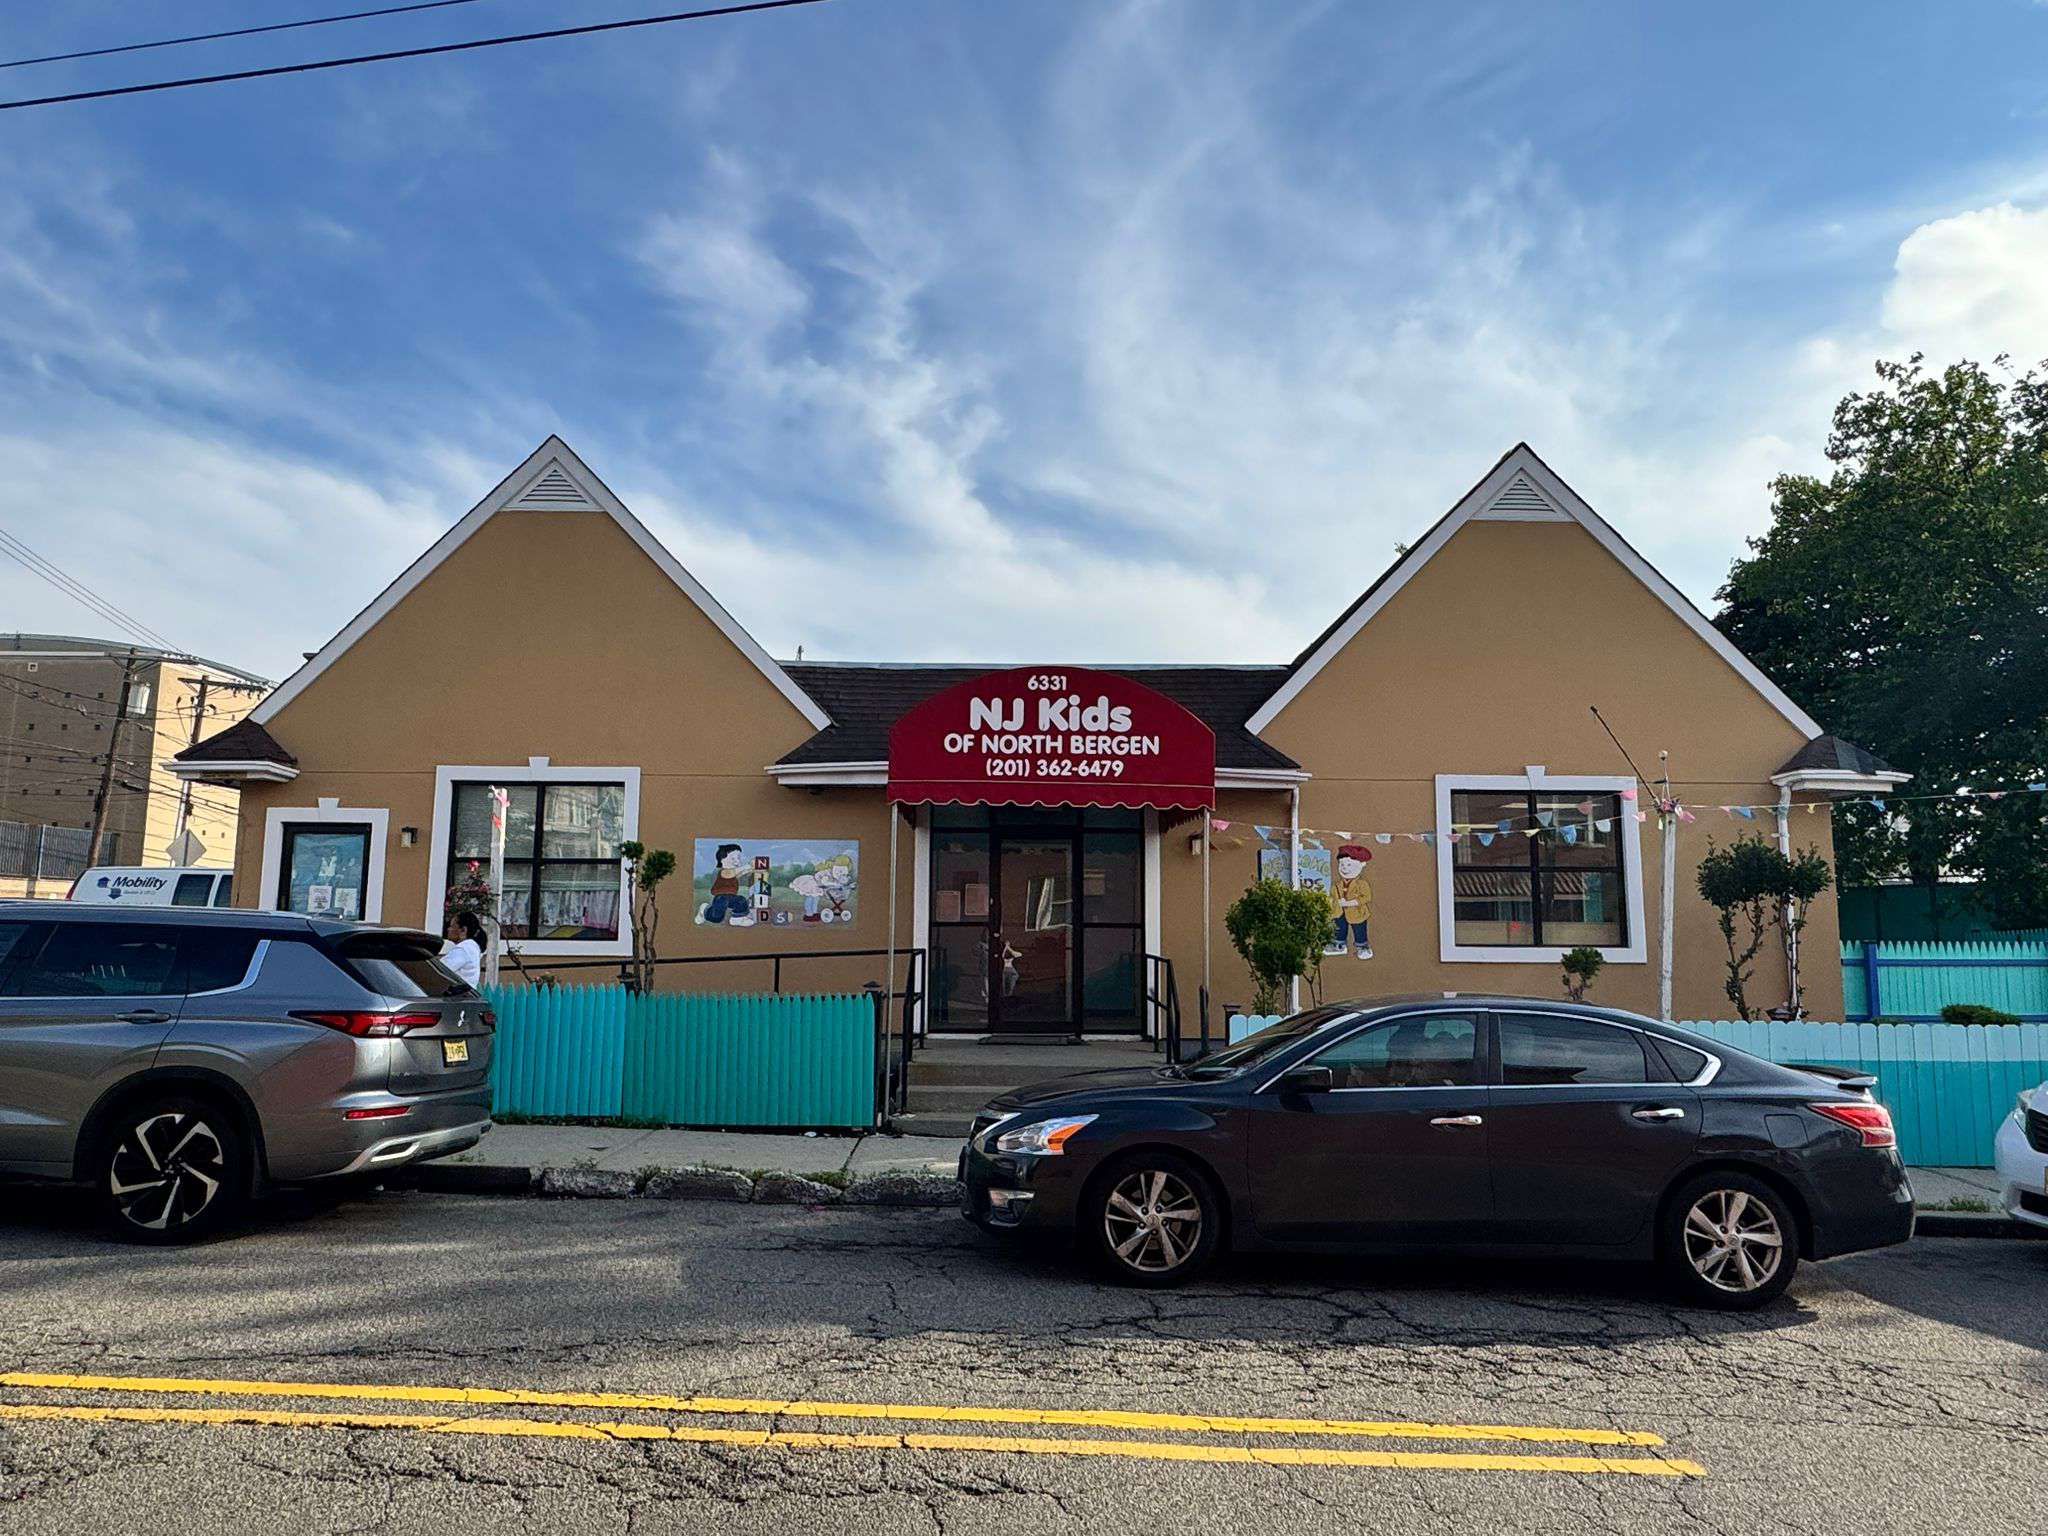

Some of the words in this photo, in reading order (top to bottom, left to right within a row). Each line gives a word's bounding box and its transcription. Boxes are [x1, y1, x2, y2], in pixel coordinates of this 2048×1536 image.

[1027, 675, 1067, 691] 6331
[969, 696, 1025, 732] NJ
[1038, 694, 1133, 732] Kids
[943, 733, 975, 754] OF
[981, 734, 1063, 755] NORTH
[1070, 735, 1160, 756] BERGEN
[986, 759, 1030, 777] (201)
[1036, 759, 1124, 777] 362-6479
[112, 876, 168, 890] Mobility
